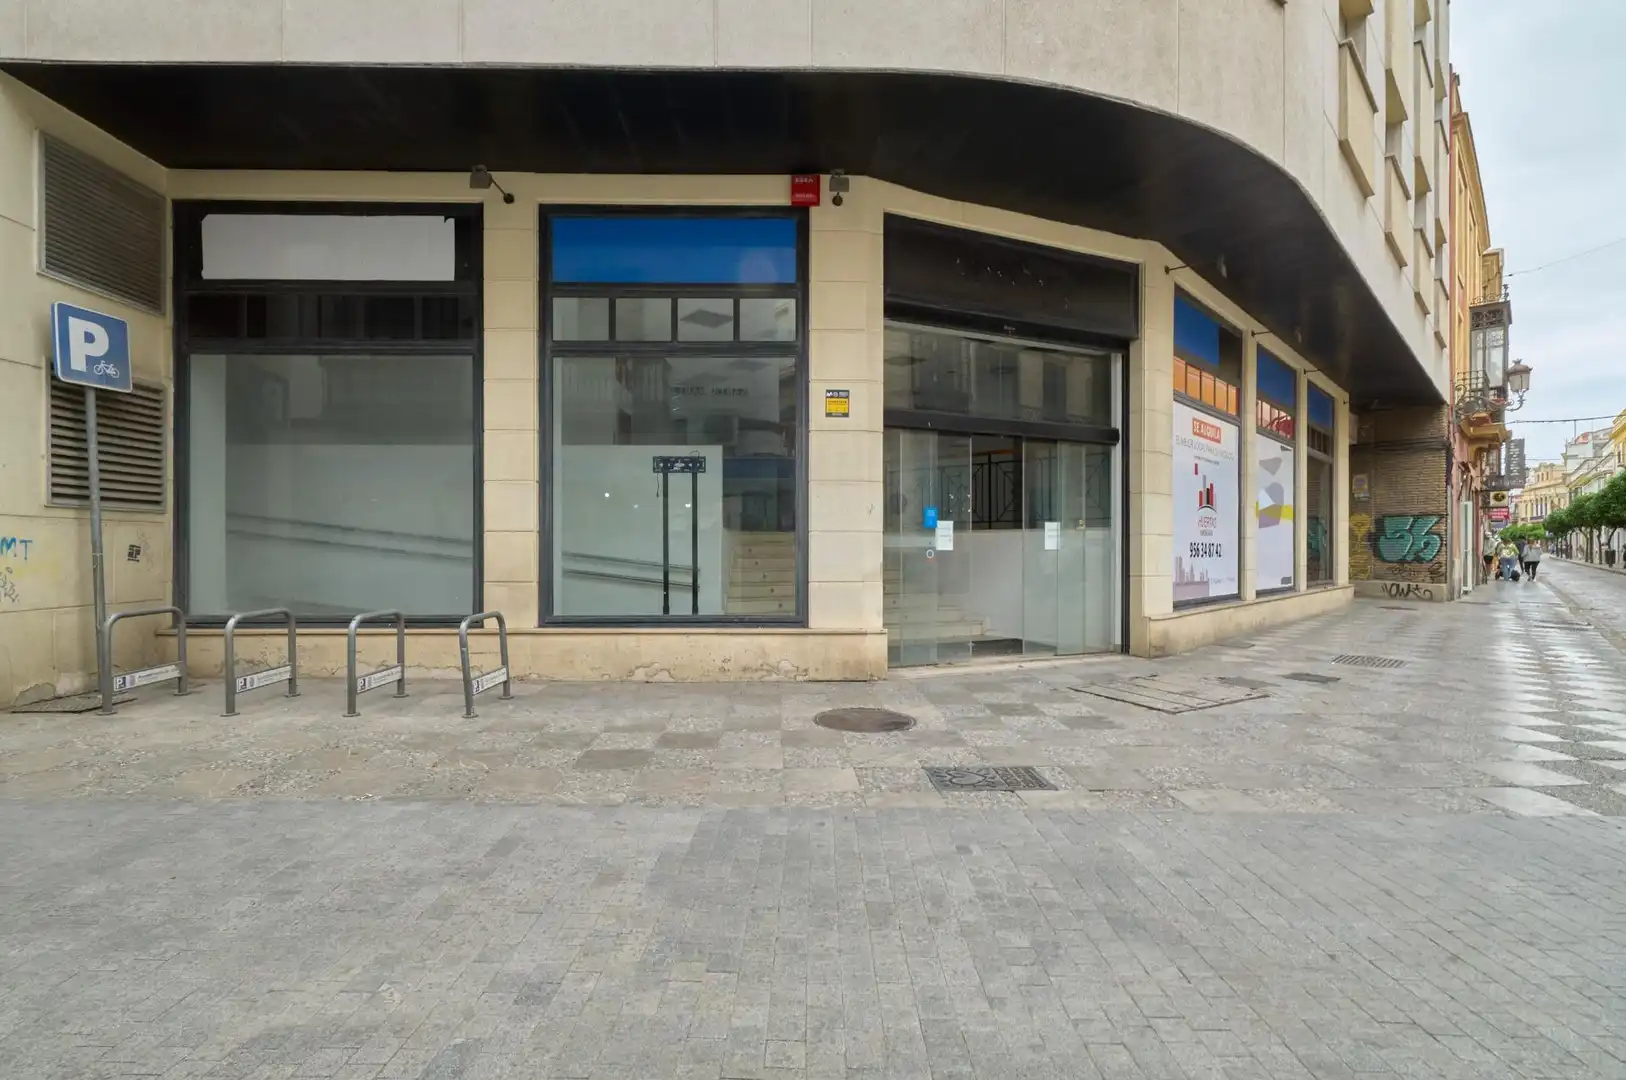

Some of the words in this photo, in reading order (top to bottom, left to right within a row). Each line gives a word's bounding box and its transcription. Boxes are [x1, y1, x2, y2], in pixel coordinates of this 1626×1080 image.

[68, 315, 110, 373] P
[1193, 420, 1200, 434] SE
[1189, 541, 1200, 558] 956
[1200, 542, 1208, 558] 34
[1208, 543, 1215, 558] 87
[1215, 543, 1222, 558] 42
